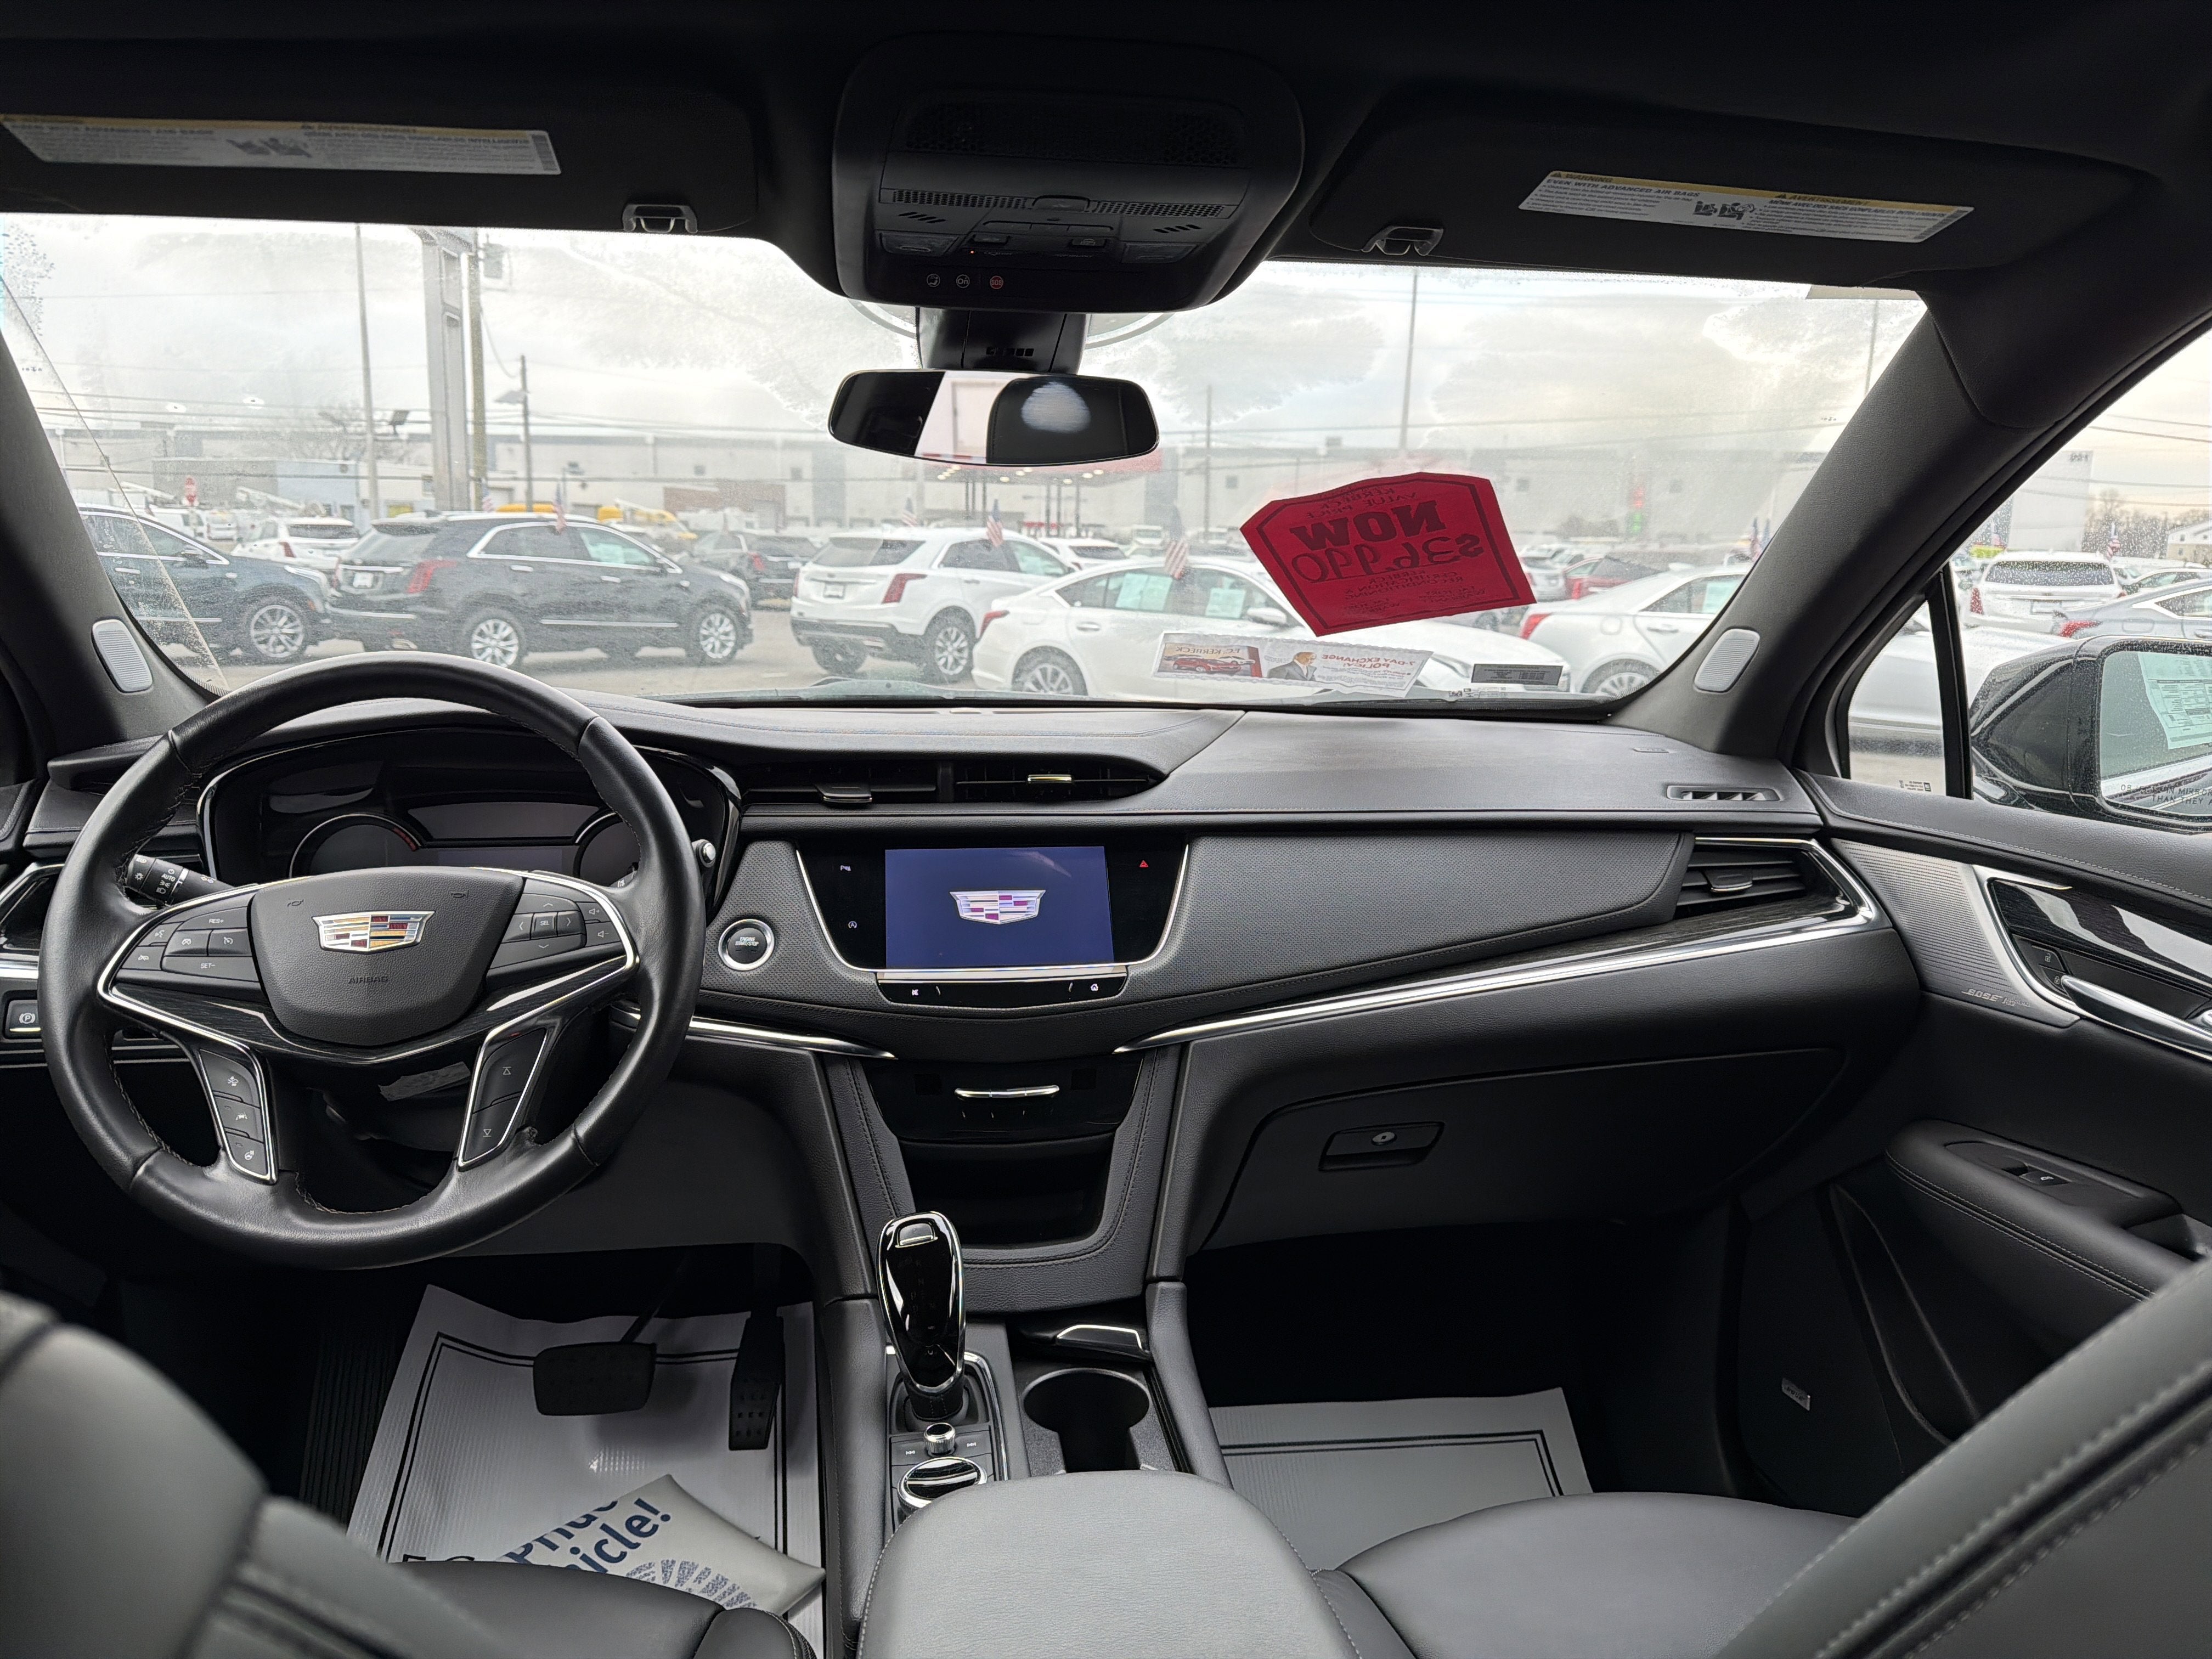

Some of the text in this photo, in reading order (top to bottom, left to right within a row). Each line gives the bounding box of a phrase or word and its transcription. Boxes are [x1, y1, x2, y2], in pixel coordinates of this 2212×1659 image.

[1566, 173, 1613, 183] WARNING
[1601, 184, 1653, 193] ADVANCED
[161, 873, 176, 882] AUTO
[348, 976, 389, 984] AIRBAG
[1961, 989, 2004, 1002] BOSE
